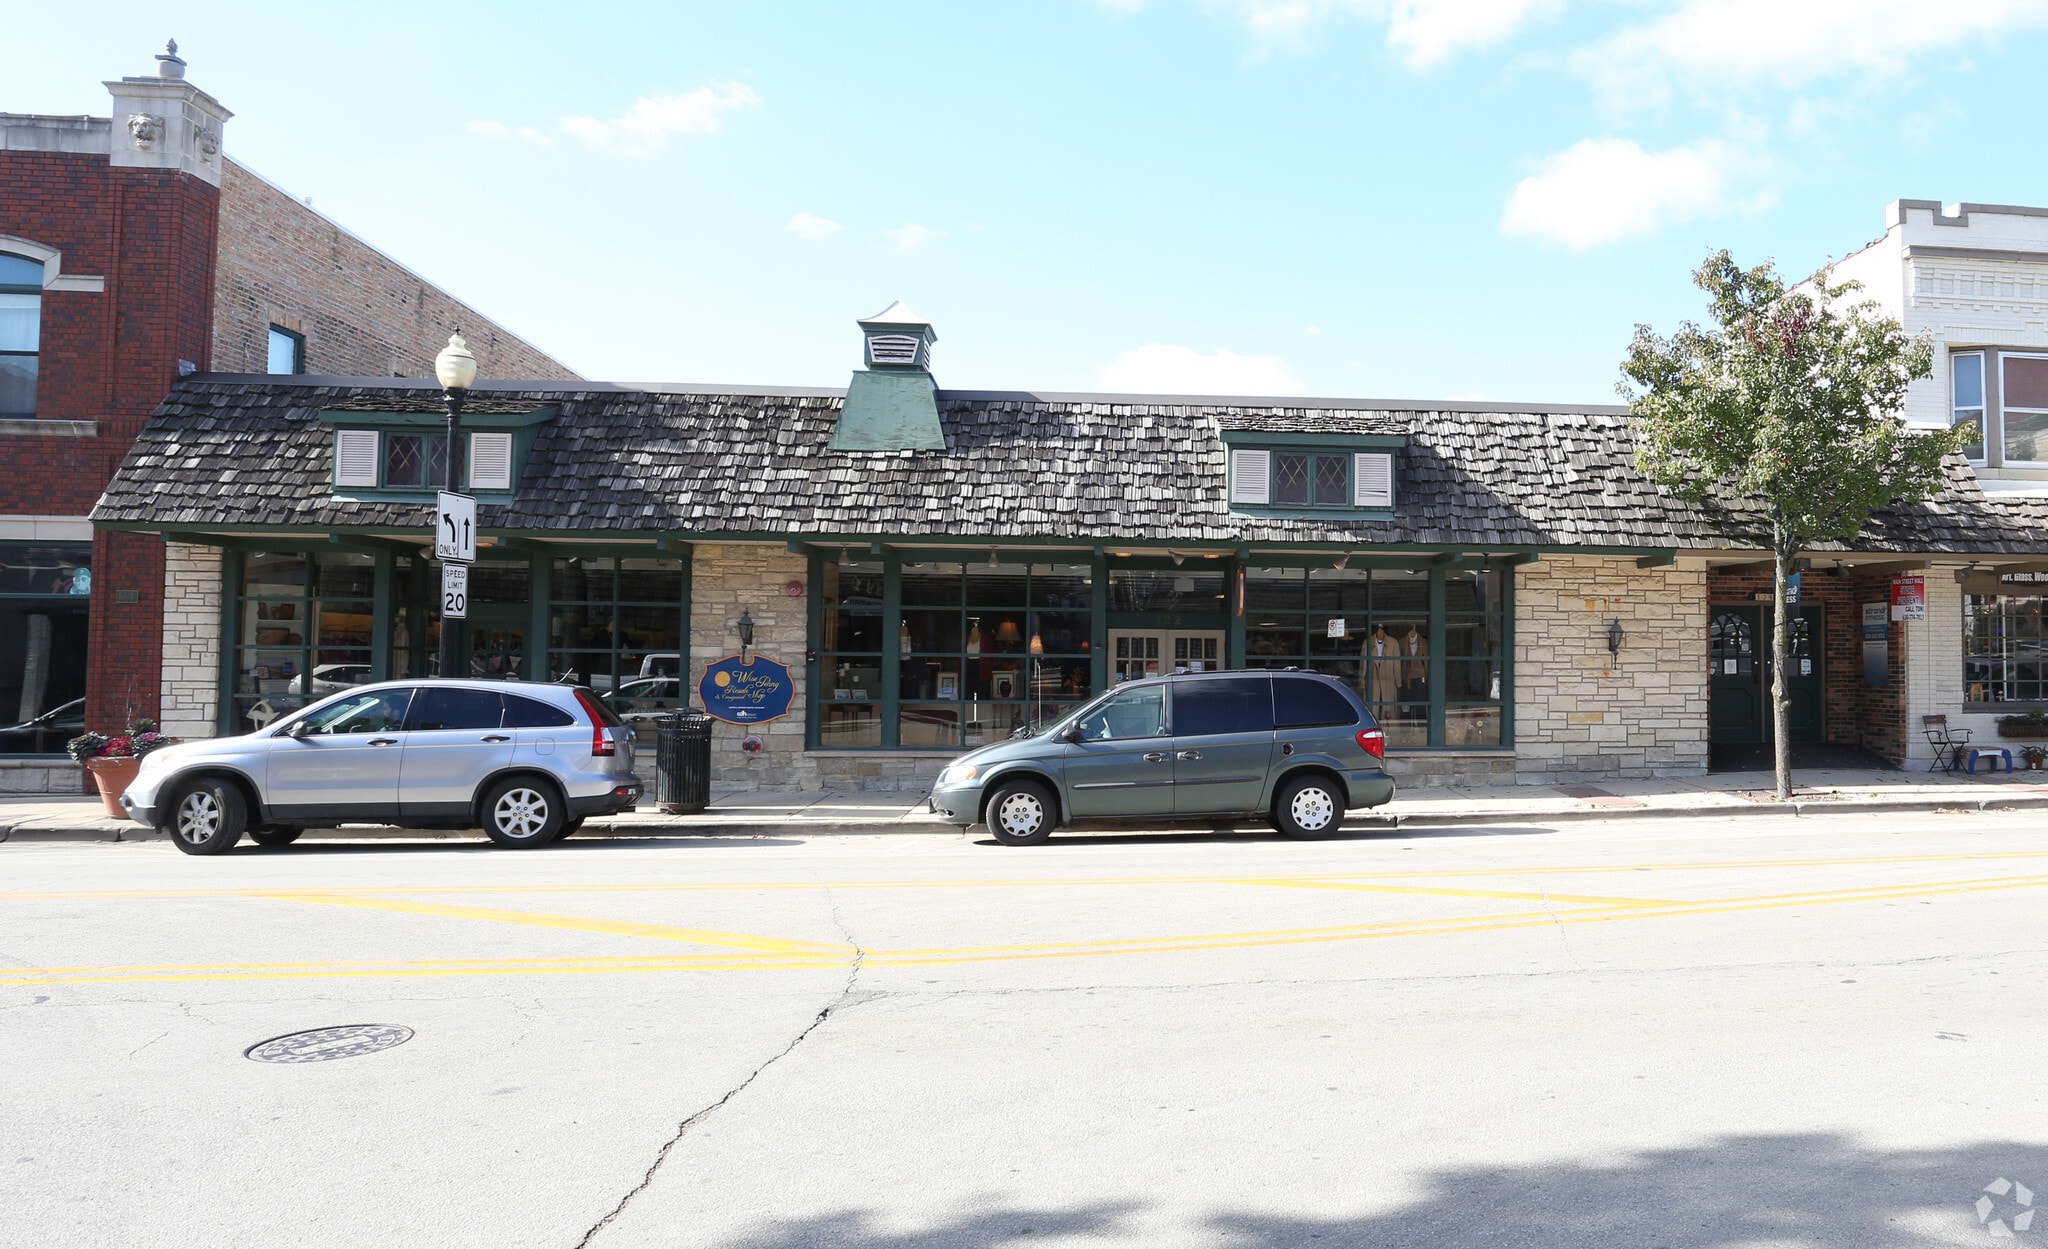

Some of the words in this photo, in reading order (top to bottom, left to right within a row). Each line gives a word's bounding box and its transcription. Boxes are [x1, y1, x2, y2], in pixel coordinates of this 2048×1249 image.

[439, 544, 456, 556] ONLY
[446, 570, 465, 578] SPEED
[445, 592, 464, 612] 20
[1907, 596, 1919, 604] RENT
[732, 670, 758, 683] Wise
[755, 676, 780, 693] Penny
[724, 684, 754, 694] Resale
[748, 689, 766, 703] Shop
